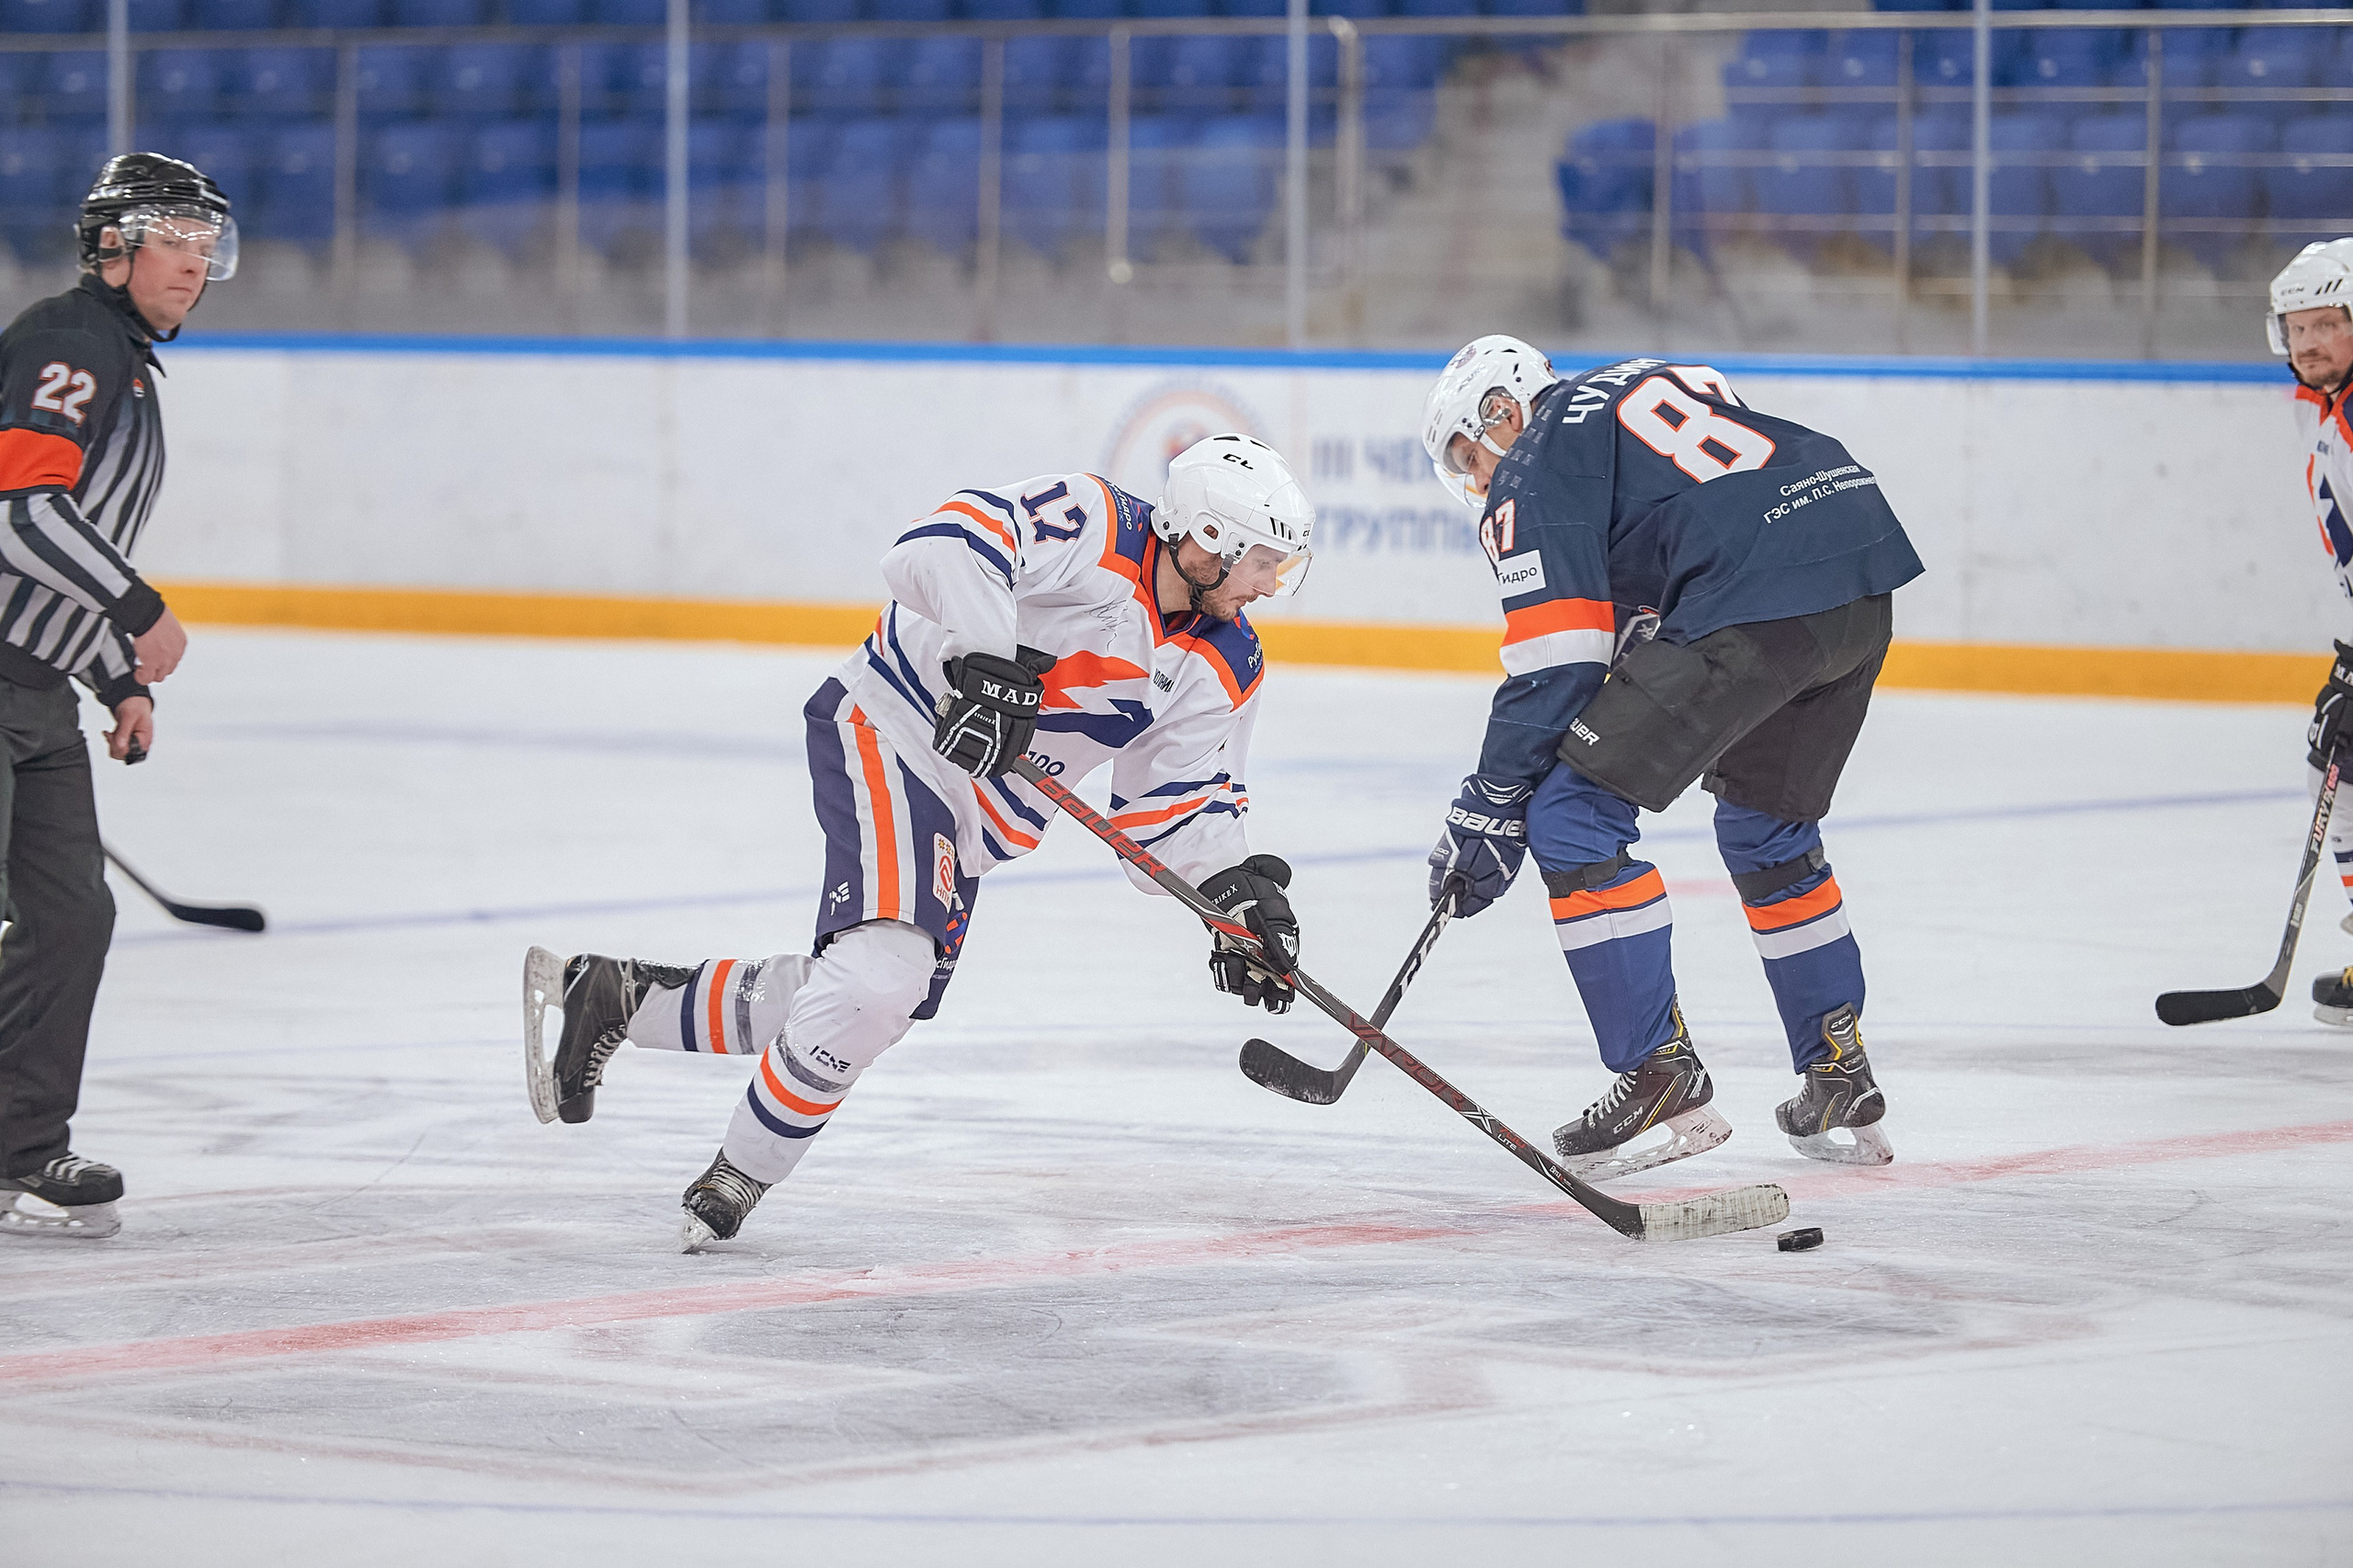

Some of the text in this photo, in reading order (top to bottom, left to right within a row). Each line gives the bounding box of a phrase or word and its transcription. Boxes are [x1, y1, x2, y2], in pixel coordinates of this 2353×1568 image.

[30, 360, 97, 427] 22
[1616, 364, 1778, 484] 87
[1019, 481, 1089, 544] 17
[1480, 497, 1516, 562] 87
[1763, 502, 1791, 524] ГЭС
[1790, 495, 1813, 510] им.
[1811, 483, 1836, 501] П.С.
[1035, 775, 1167, 879] BAUER
[1496, 1132, 1518, 1152] LITE
[1612, 1105, 1644, 1135] CCM
